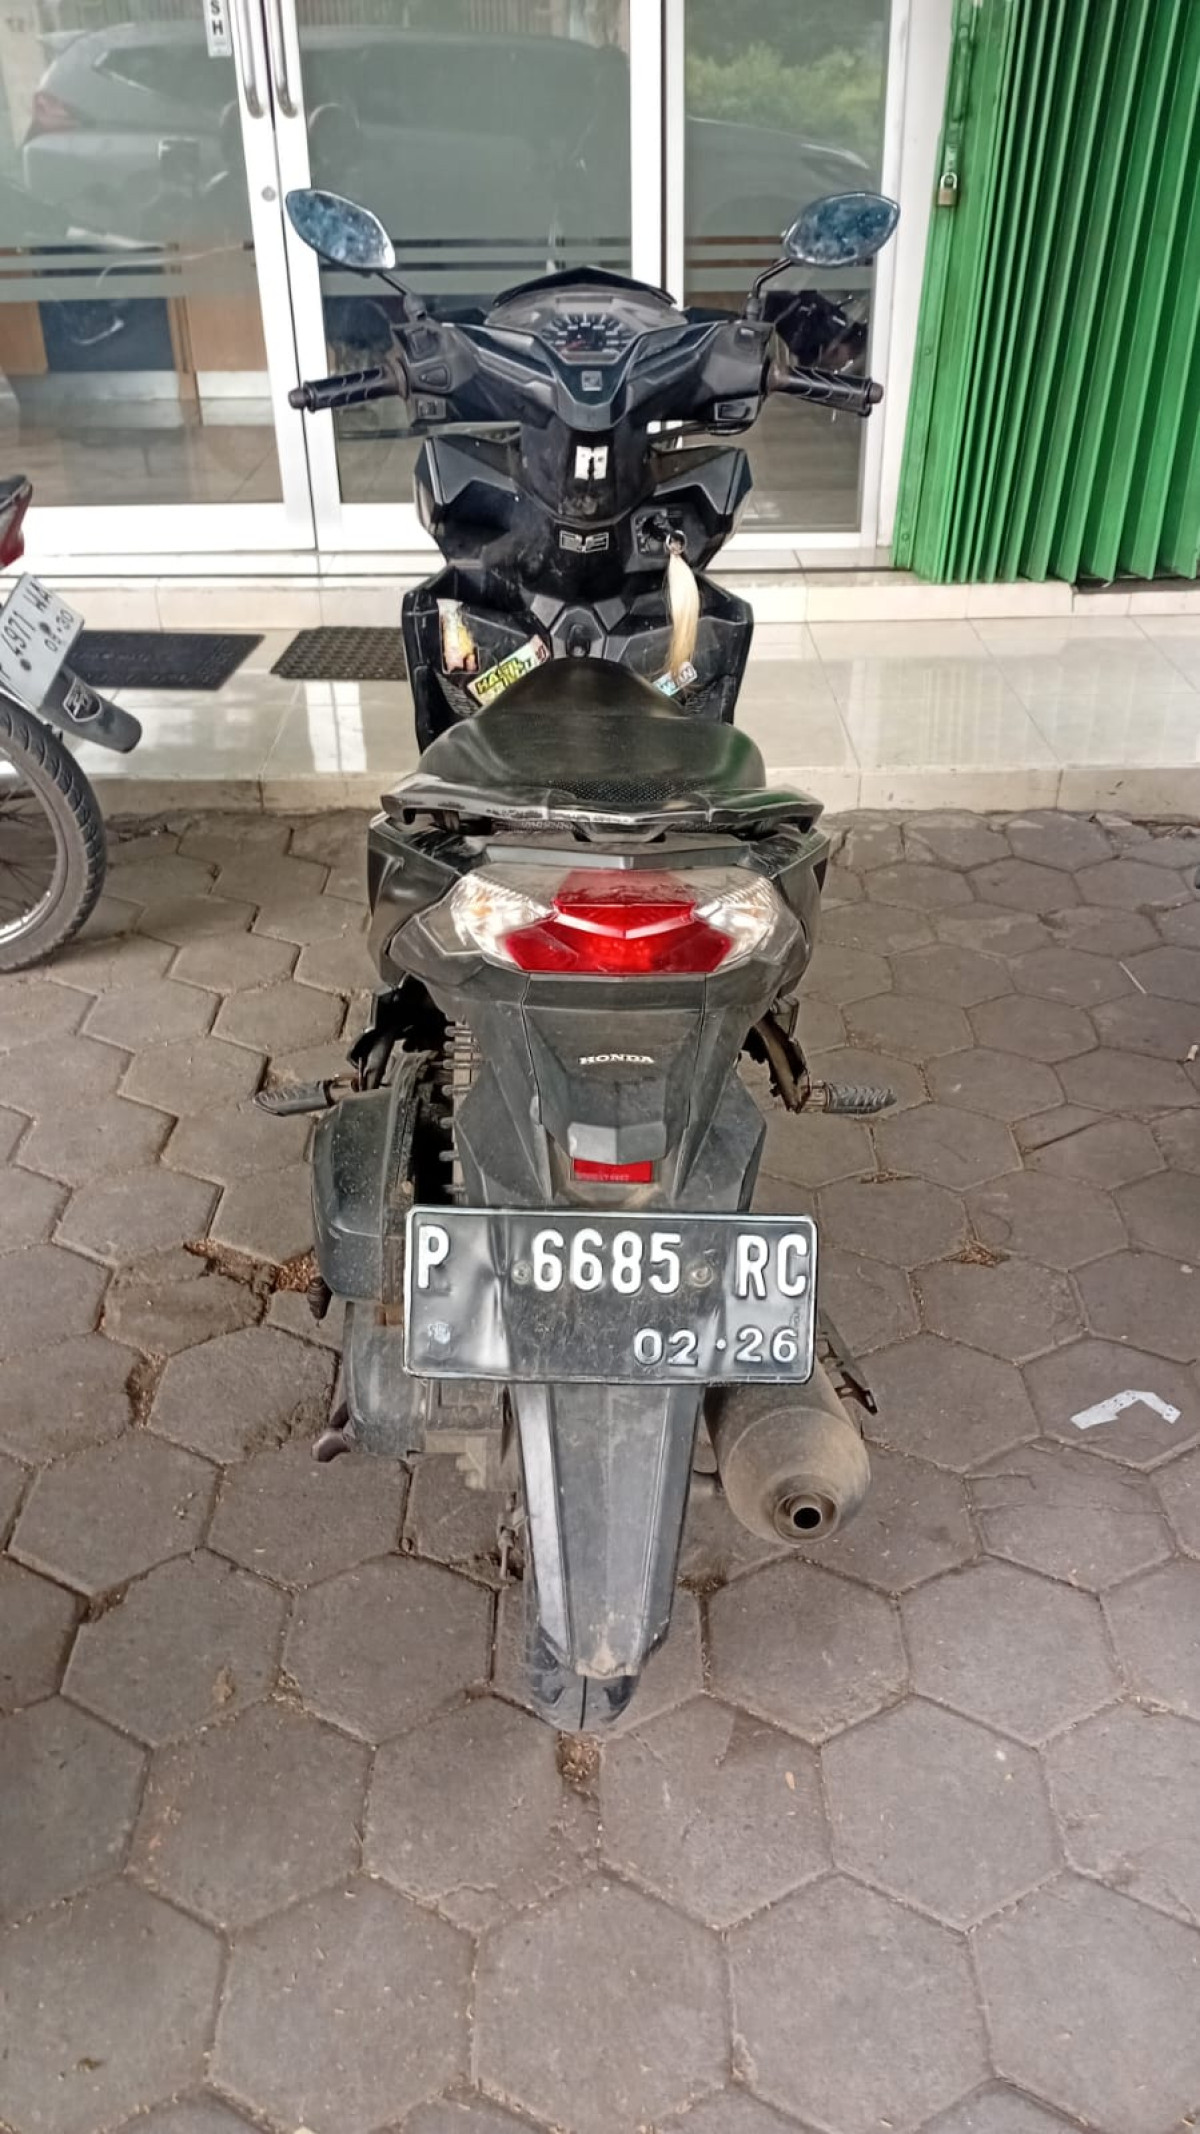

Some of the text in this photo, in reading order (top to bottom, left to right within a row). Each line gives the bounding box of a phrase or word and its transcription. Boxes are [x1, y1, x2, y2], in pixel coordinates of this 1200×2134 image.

[579, 1053, 655, 1065] HONDA
[417, 1224, 808, 1299] P 6685 RC
